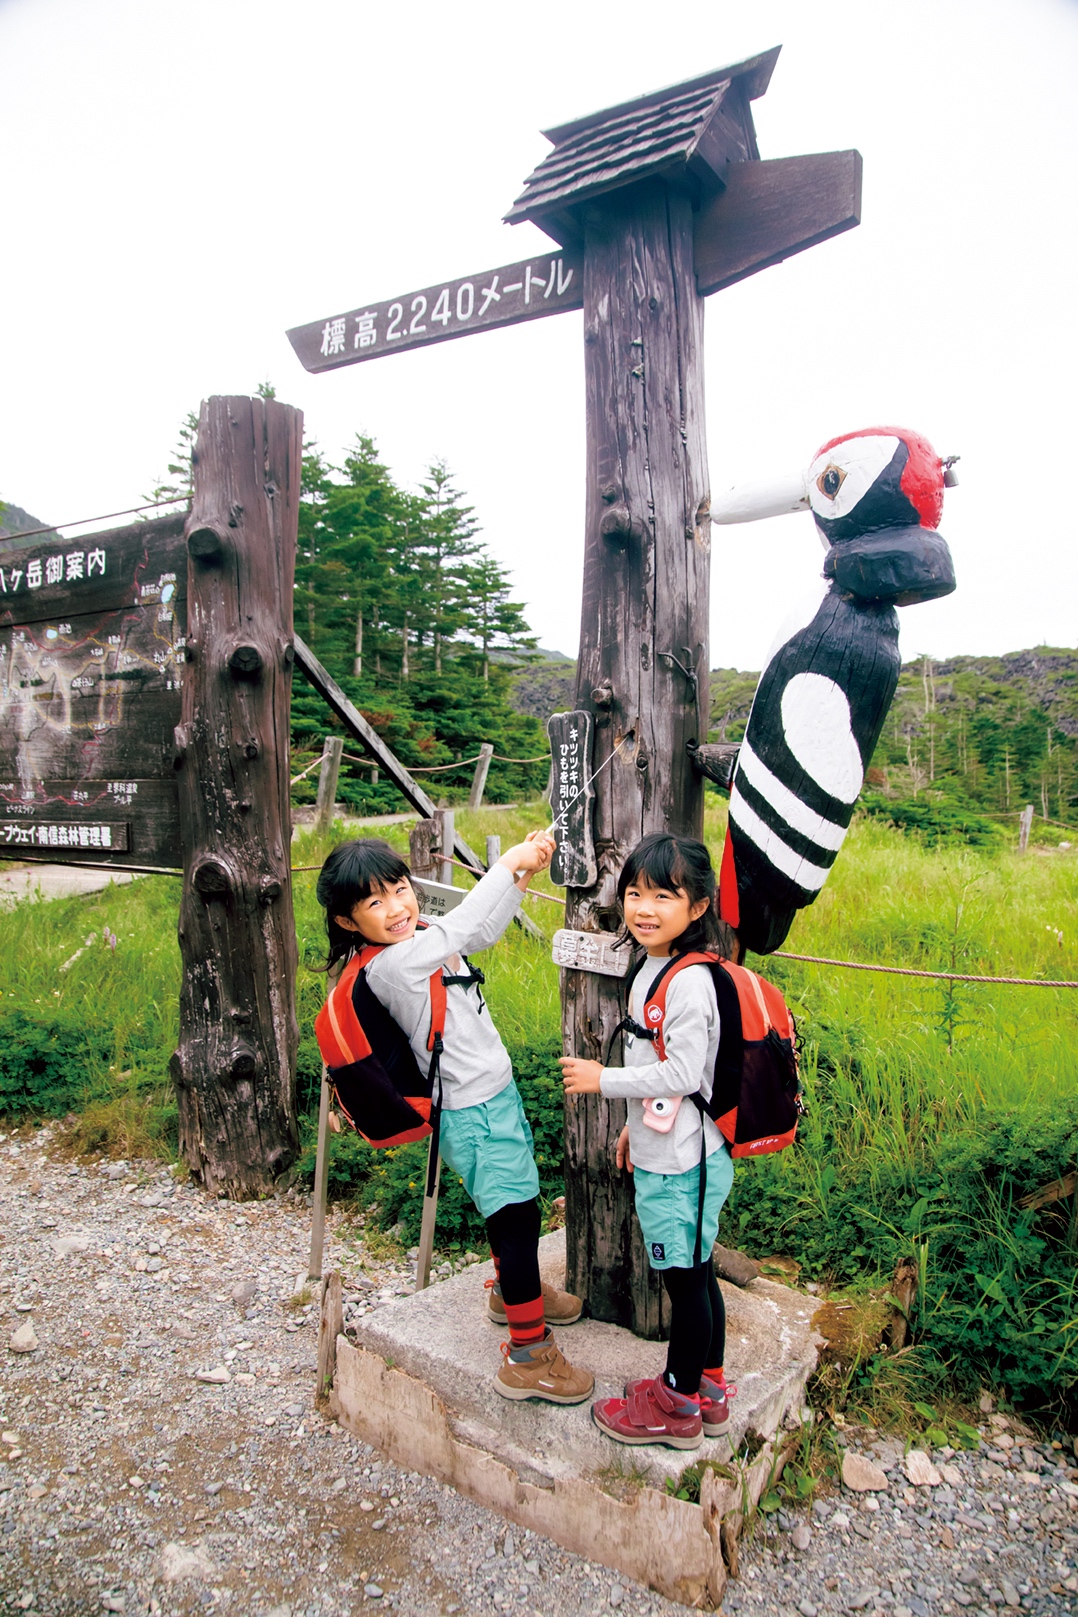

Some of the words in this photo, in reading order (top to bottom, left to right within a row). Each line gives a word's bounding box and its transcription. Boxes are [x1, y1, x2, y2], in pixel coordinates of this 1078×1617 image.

[320, 258, 573, 356] 標高2.240メートル
[569, 728, 579, 798] キツツキの
